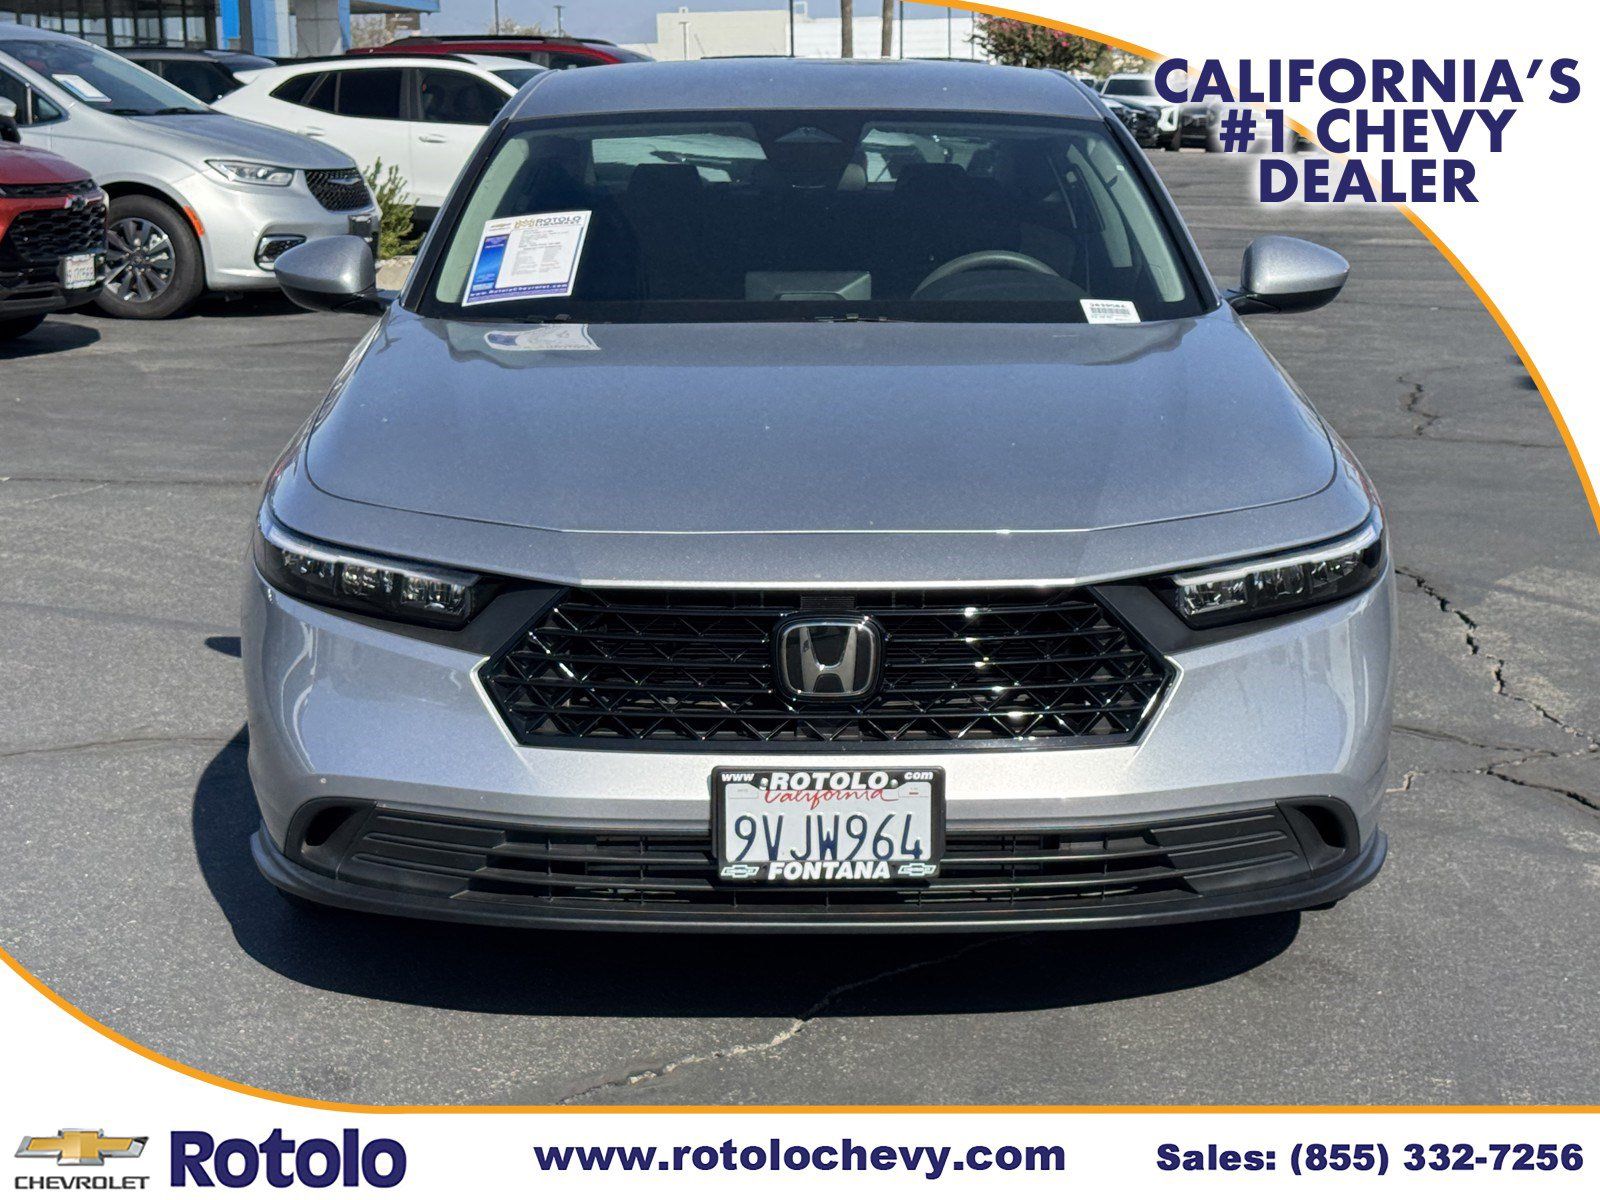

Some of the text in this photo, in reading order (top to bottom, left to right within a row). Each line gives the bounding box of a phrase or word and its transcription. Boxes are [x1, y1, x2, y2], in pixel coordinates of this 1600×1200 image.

[721, 773, 755, 782] www
[903, 771, 933, 780] com
[764, 788, 899, 810] California
[734, 812, 924, 862] 9VJW964
[768, 861, 891, 880] FONTANA
